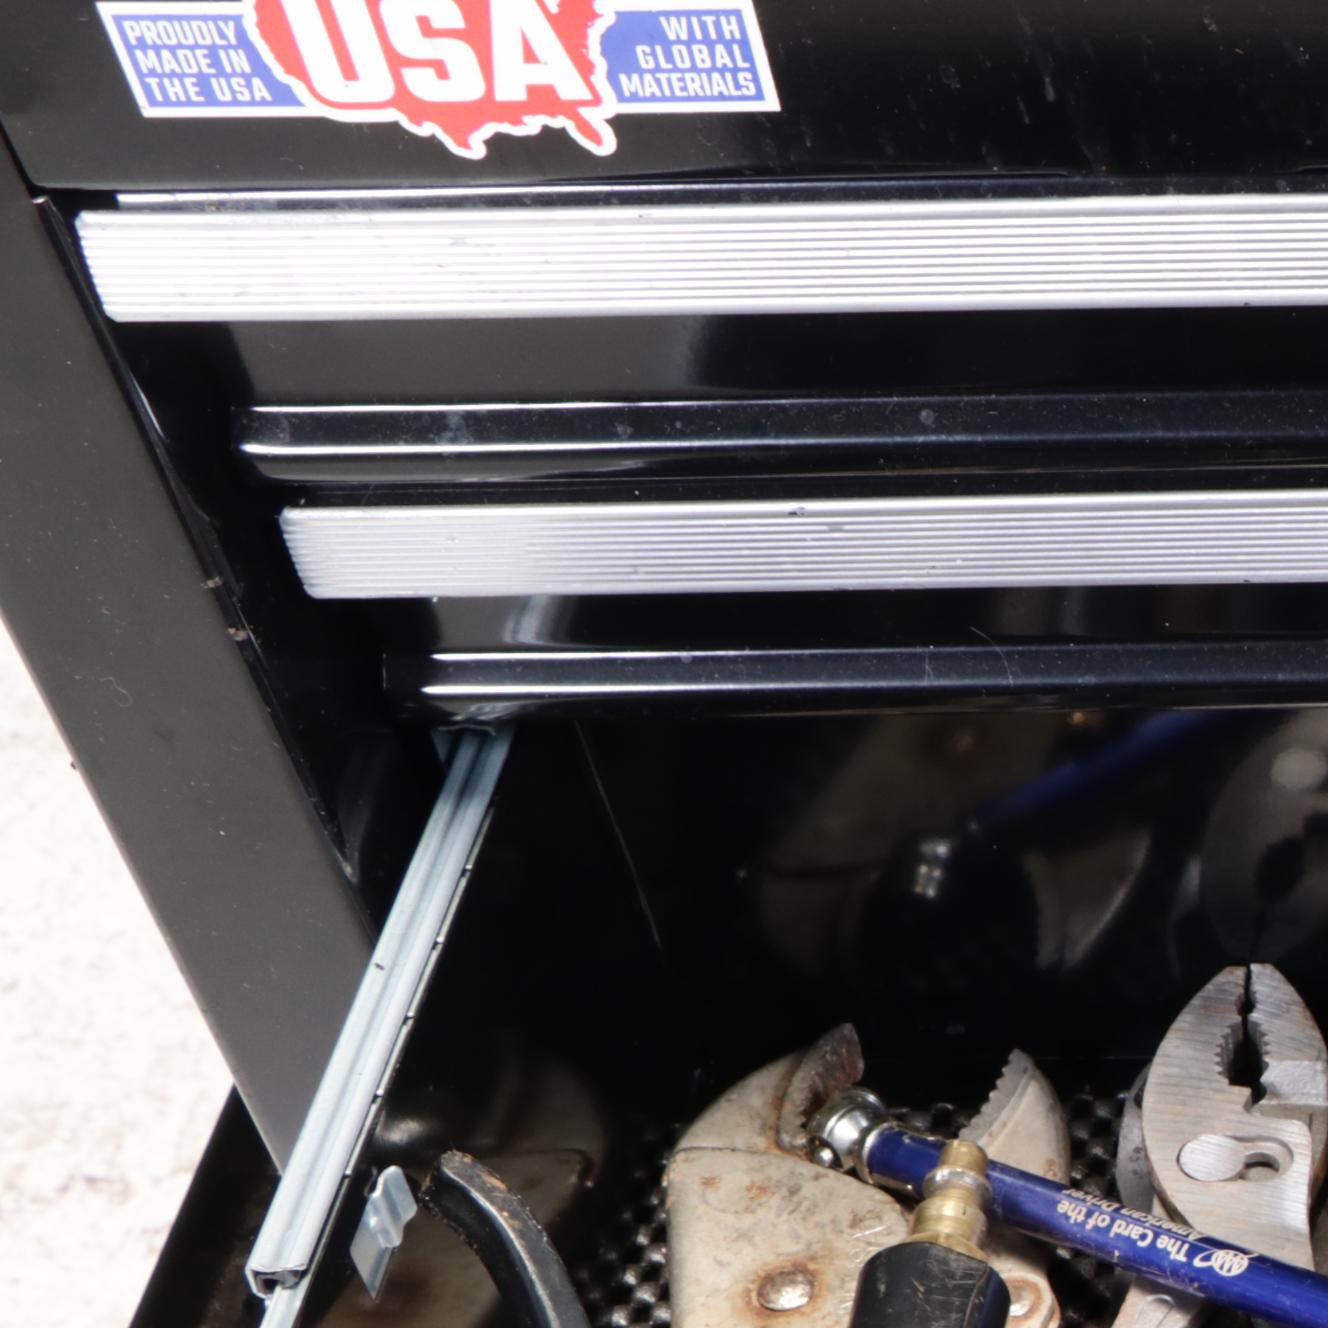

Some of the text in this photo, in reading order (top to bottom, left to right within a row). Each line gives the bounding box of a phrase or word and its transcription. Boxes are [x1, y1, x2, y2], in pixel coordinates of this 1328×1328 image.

[122, 20, 238, 46] PROUDLY
[659, 15, 742, 41] WITH
[134, 49, 252, 74] MADE IN
[283, 0, 594, 103] USA
[634, 43, 750, 70] GLOBAL
[144, 77, 273, 102] THE USA
[618, 71, 757, 98] MATERIALS
[1062, 1188, 1207, 1240] American Driver
[1057, 1199, 1191, 1262] The Card of the
